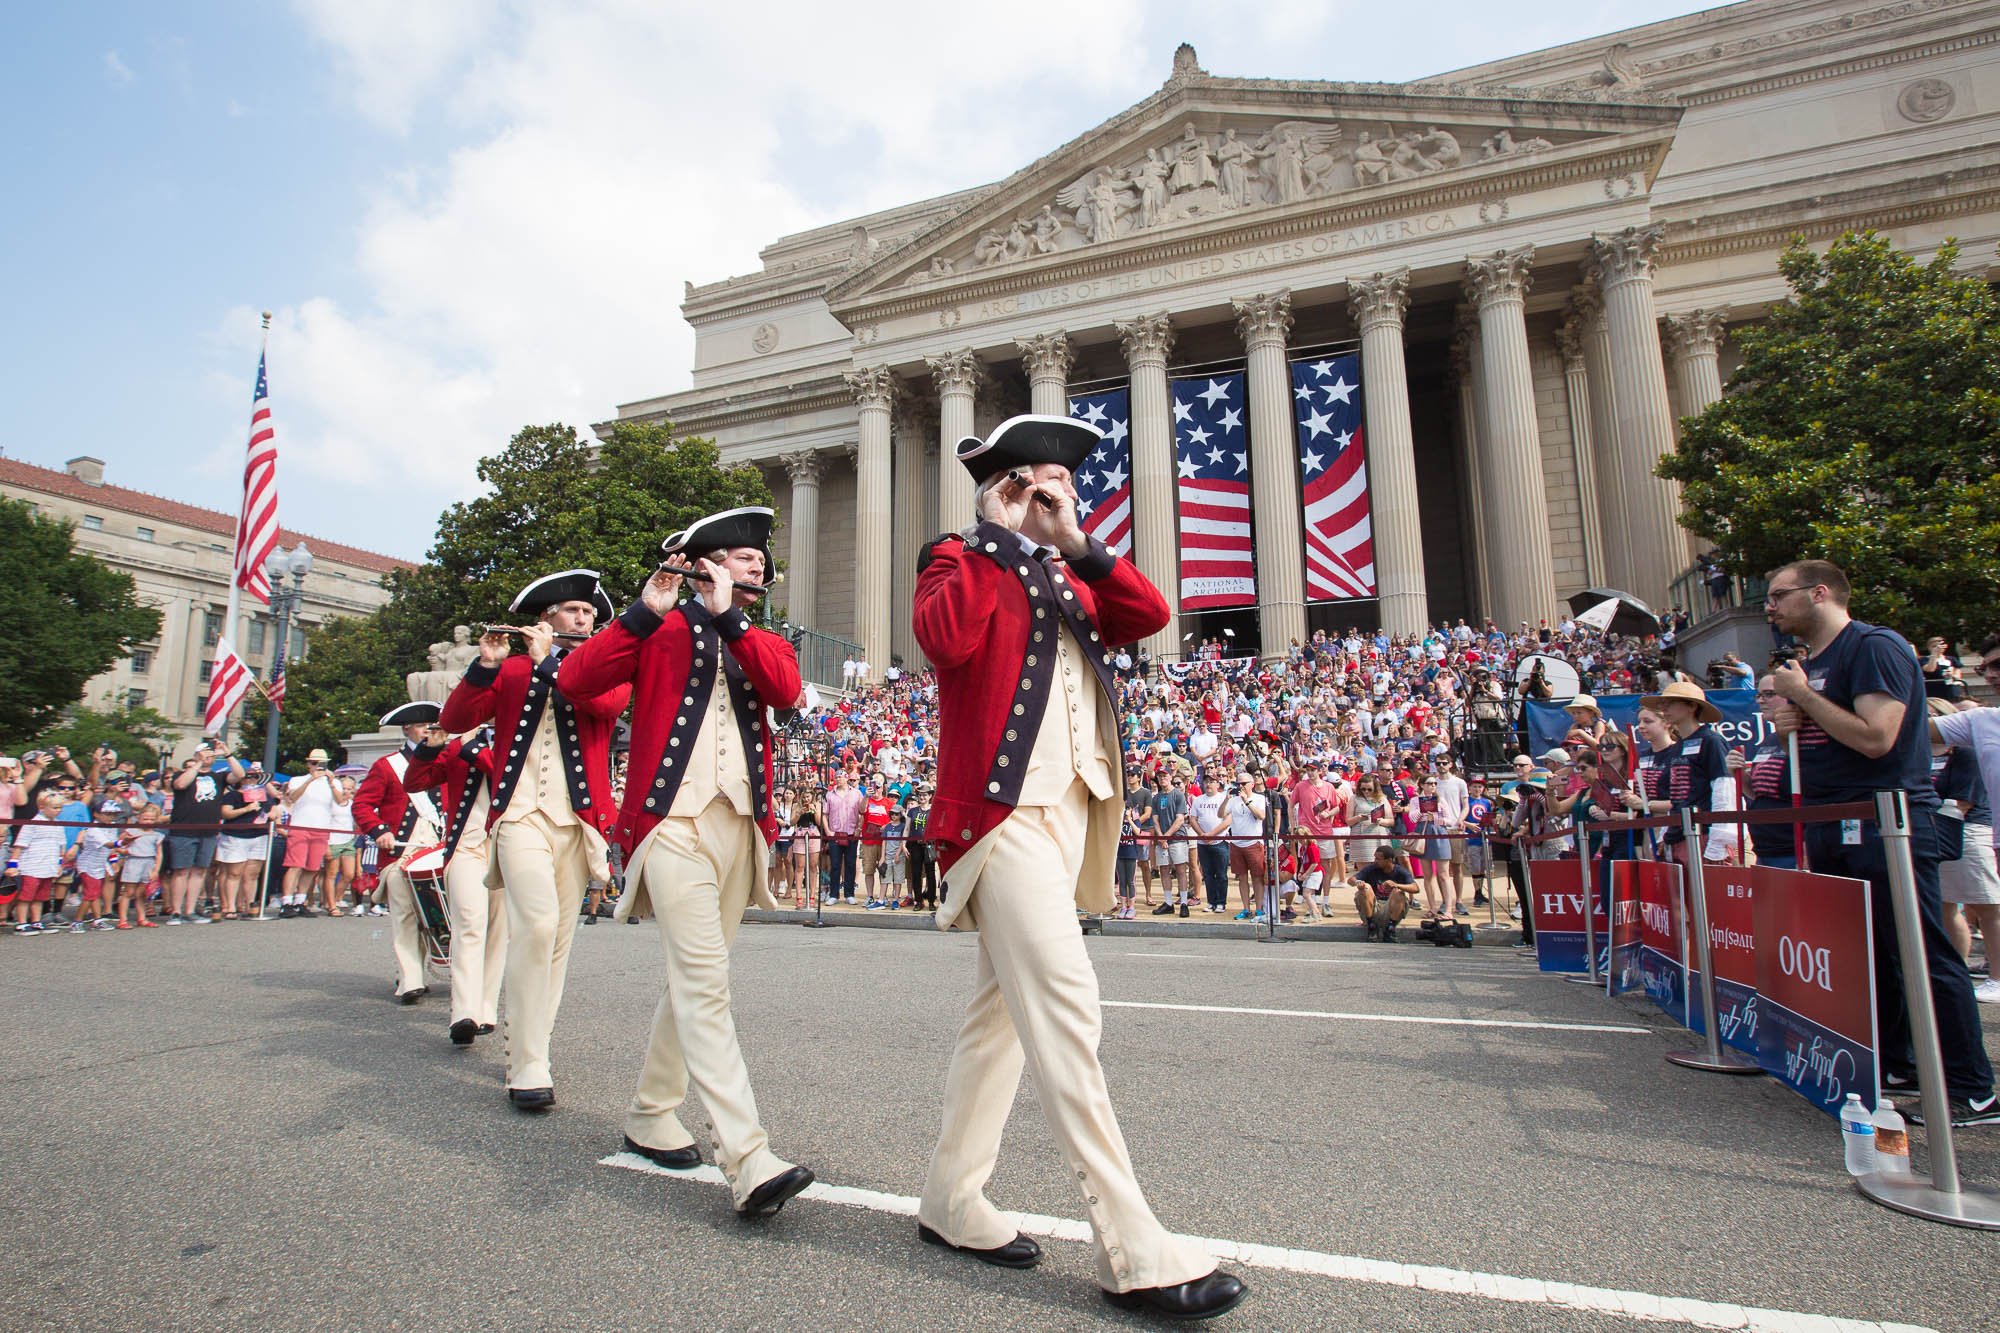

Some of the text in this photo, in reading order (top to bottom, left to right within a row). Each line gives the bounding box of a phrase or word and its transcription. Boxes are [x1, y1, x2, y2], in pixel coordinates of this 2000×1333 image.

[980, 213, 1456, 319] ARCHIVES OF THE UNITED STATES OF AMERICA
[1193, 578, 1244, 588] NATIONAL
[1193, 585, 1244, 595] ARCHIVES
[1541, 893, 1606, 915] ZAH
[1779, 935, 1832, 992] BOO
[1741, 997, 1758, 1039] ly
[1785, 1035, 1856, 1104] July 4th
